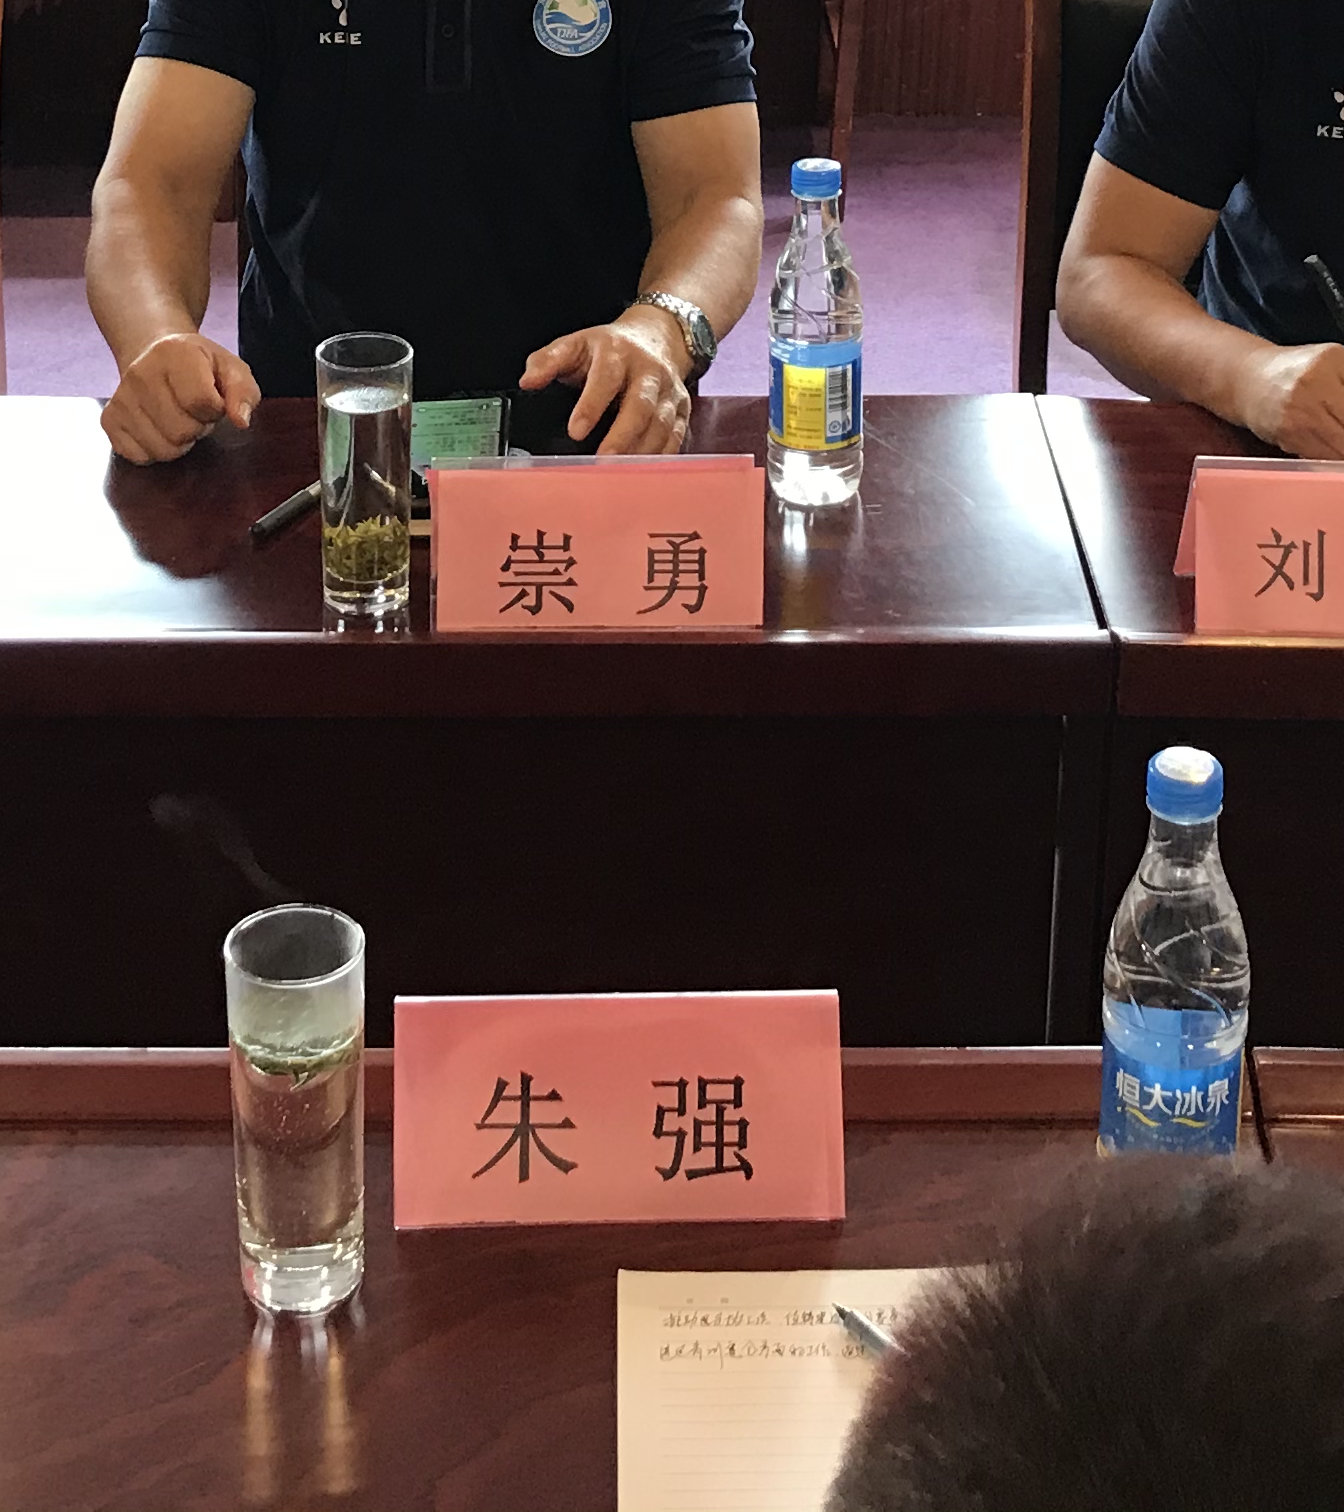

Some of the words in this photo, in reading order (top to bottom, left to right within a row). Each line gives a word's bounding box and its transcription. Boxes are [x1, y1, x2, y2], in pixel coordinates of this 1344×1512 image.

[319, 31, 362, 45] KEE
[497, 528, 709, 616] 崇勇
[1116, 1068, 1230, 1116] 恒大冰泉
[472, 1070, 755, 1184] 朱强
